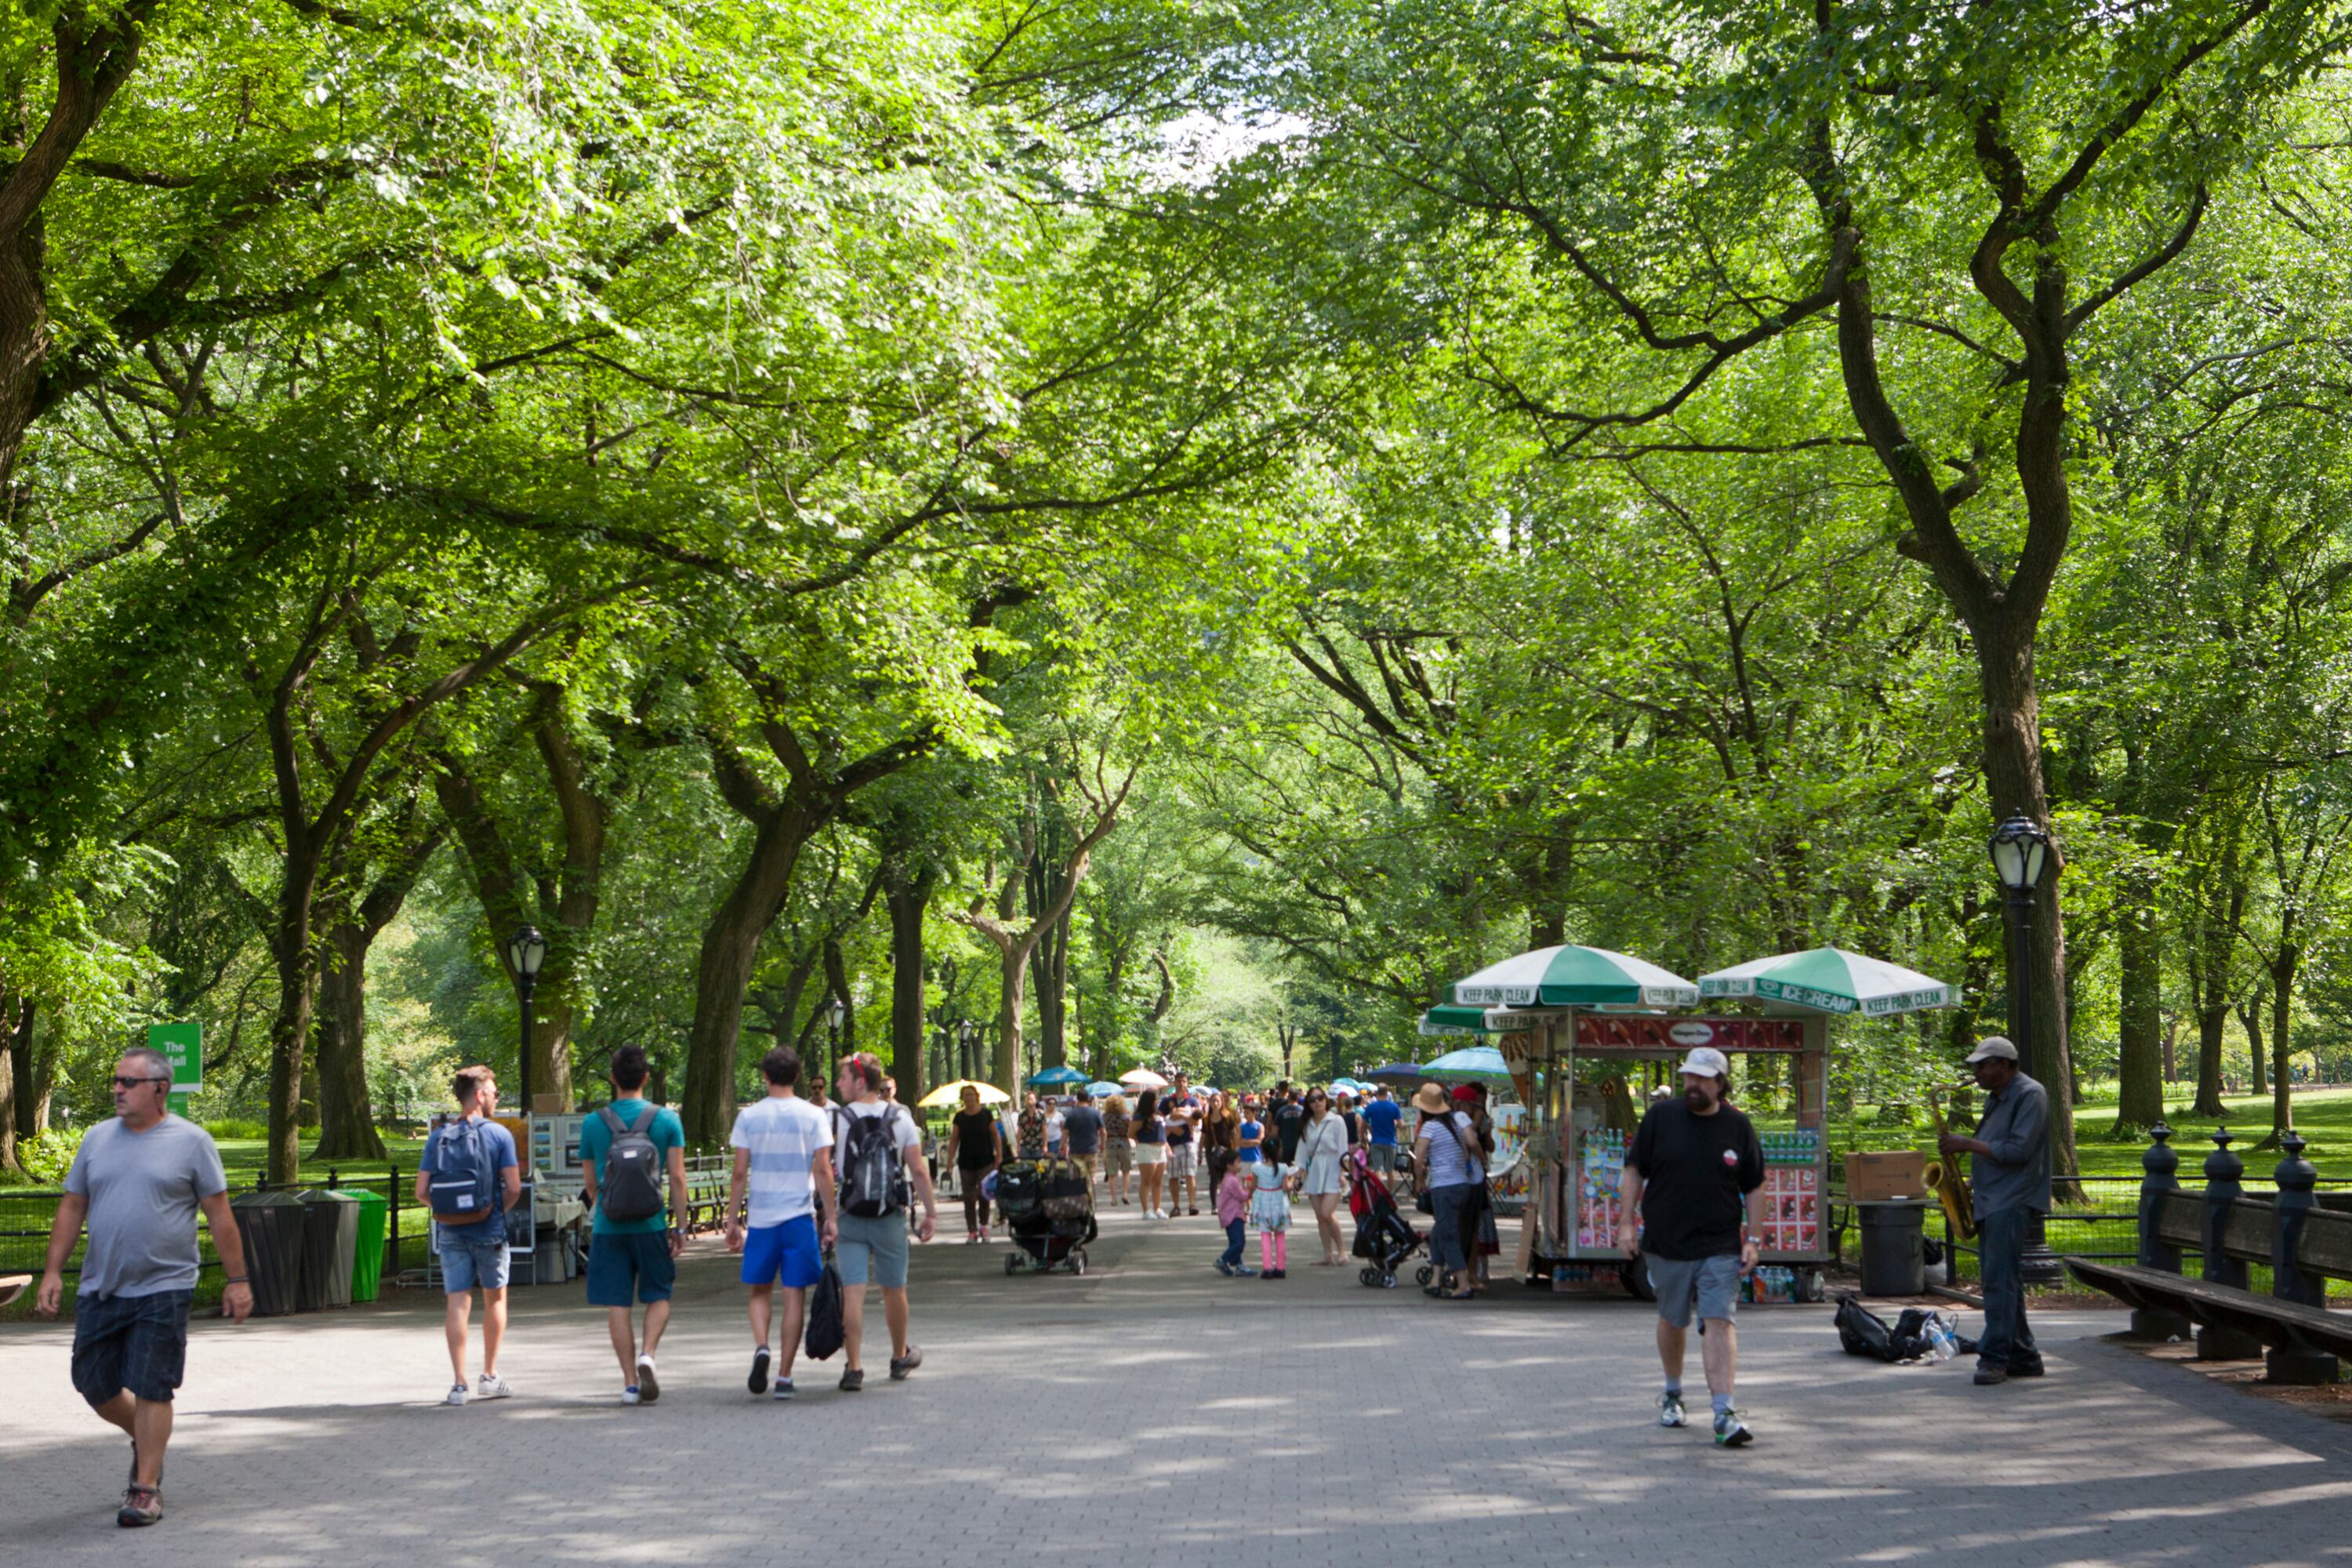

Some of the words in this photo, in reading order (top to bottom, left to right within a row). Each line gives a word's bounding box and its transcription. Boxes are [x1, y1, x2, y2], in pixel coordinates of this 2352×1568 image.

[1463, 989, 1483, 1002] KEEP
[1484, 989, 1504, 1002] PARK
[1506, 989, 1530, 1002] CLEAN
[1781, 984, 1803, 1002] ICE
[1804, 989, 1853, 1012] CREAM
[1867, 997, 1889, 1013] KEEP
[1891, 992, 1914, 1010] PARK
[1915, 990, 1941, 1006] CLEAN
[1492, 1015, 1515, 1028] KEEP
[164, 1041, 185, 1052] The
